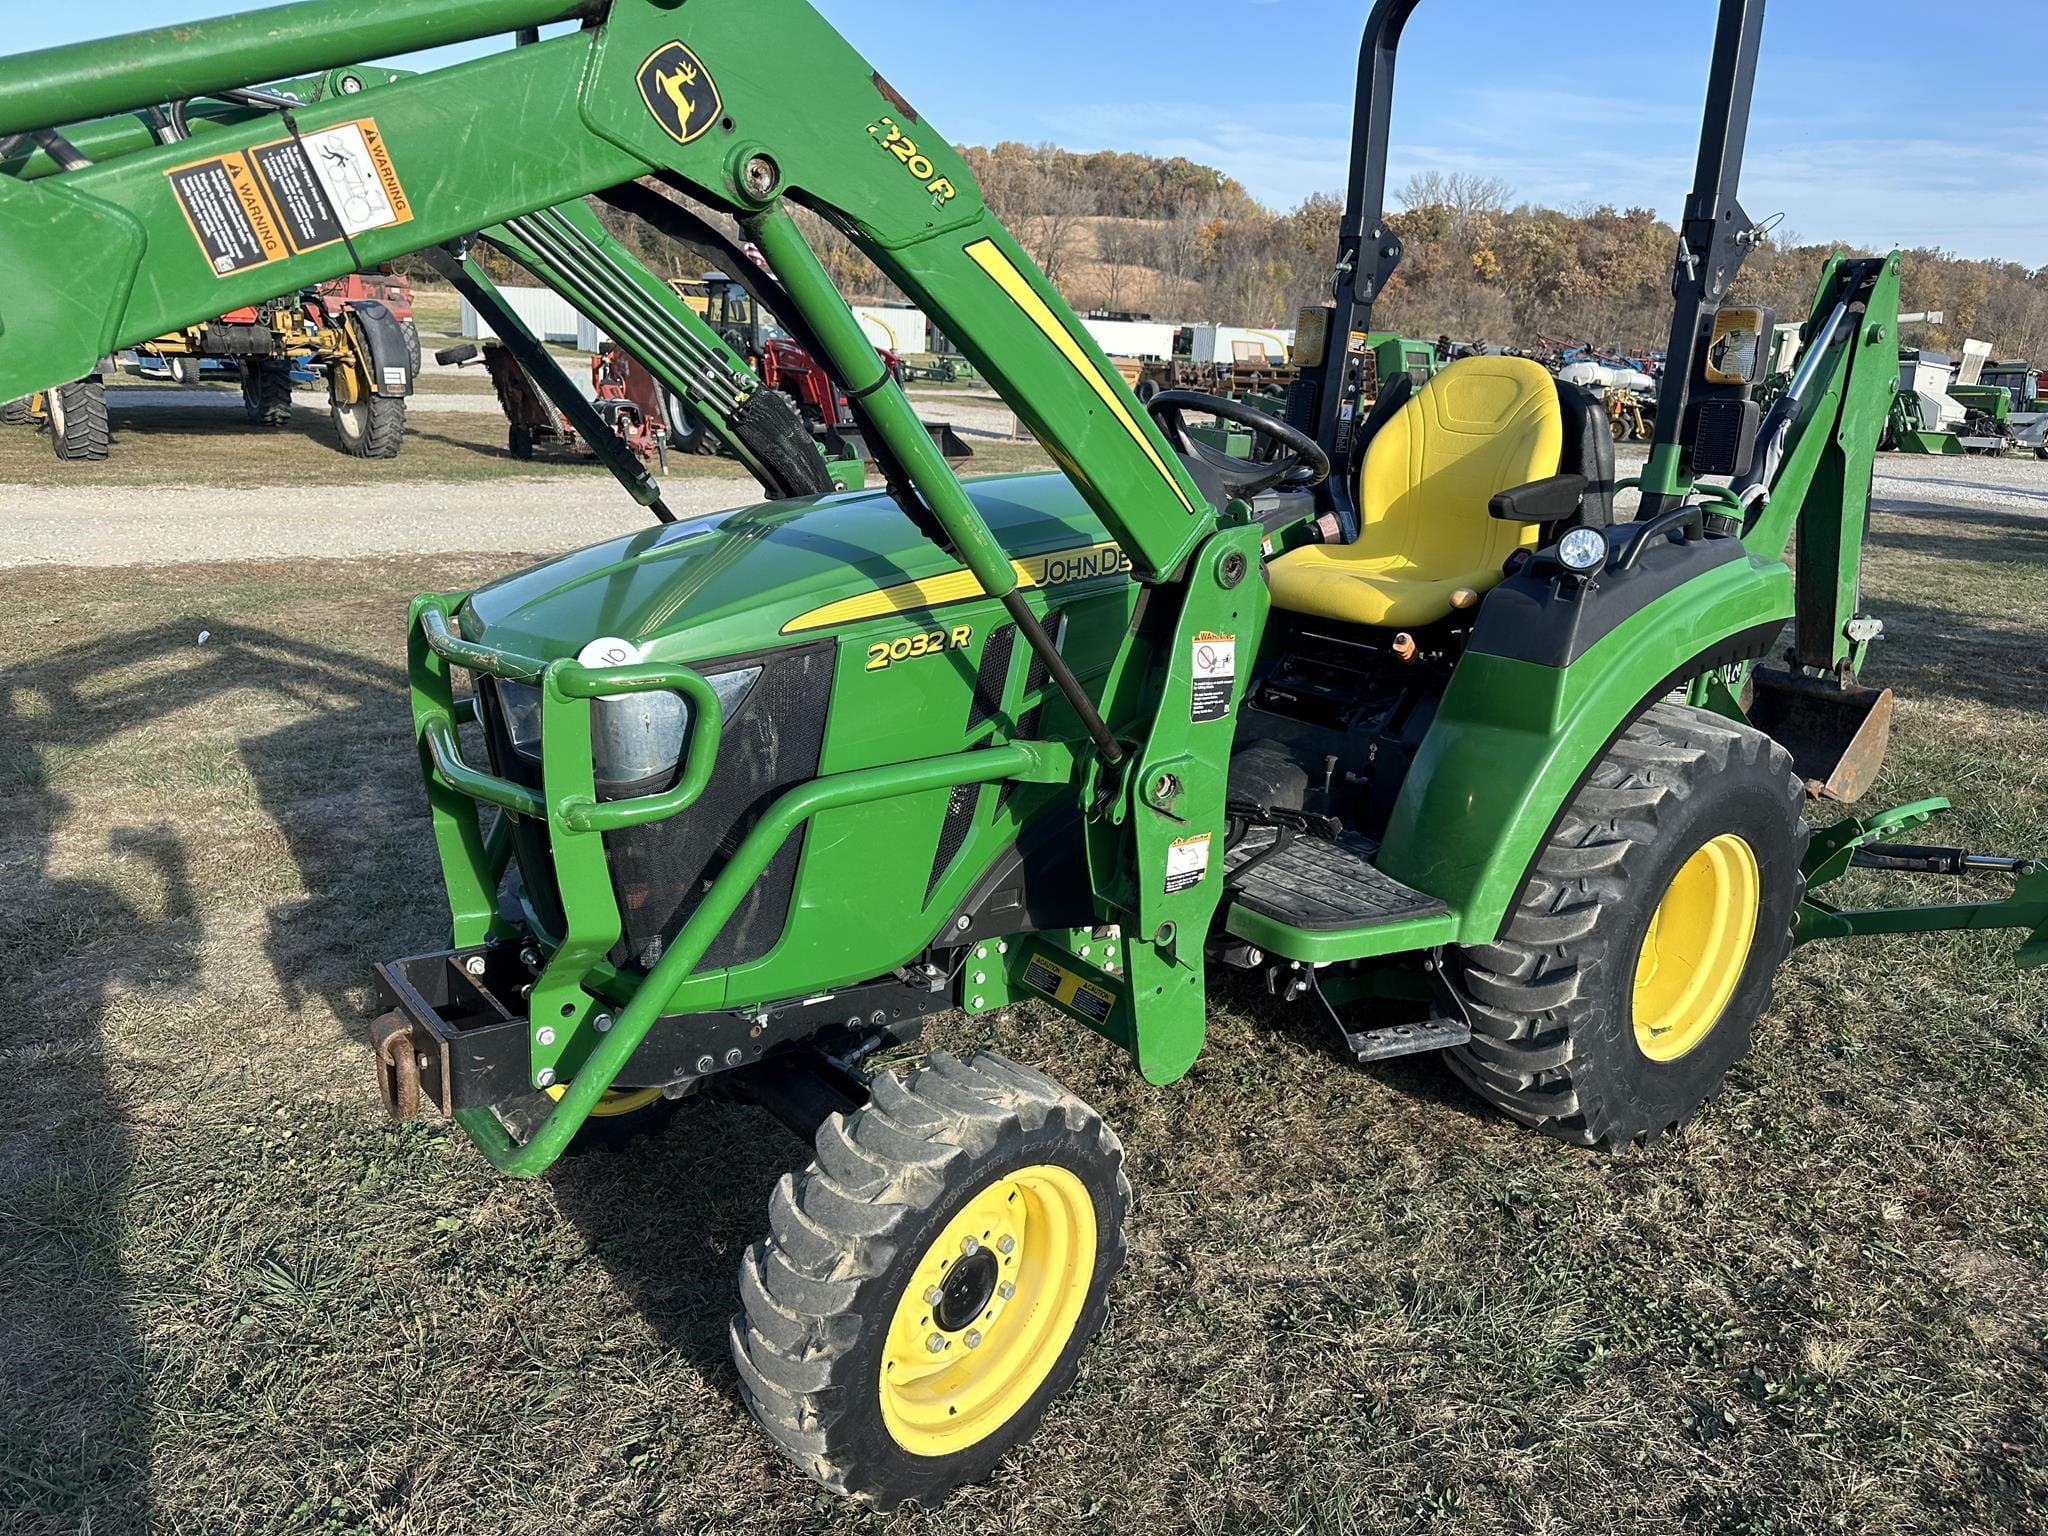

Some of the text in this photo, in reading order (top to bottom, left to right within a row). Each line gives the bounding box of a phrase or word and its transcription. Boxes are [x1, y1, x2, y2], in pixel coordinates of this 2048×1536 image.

[372, 146, 406, 211] WARNING
[926, 174, 957, 209] R
[240, 183, 277, 250] WARNING
[1035, 554, 1098, 586] JOHN
[865, 624, 973, 672] 2032 R
[1039, 958, 1061, 974] CAUTION
[1087, 984, 1110, 1001] CAUTION
